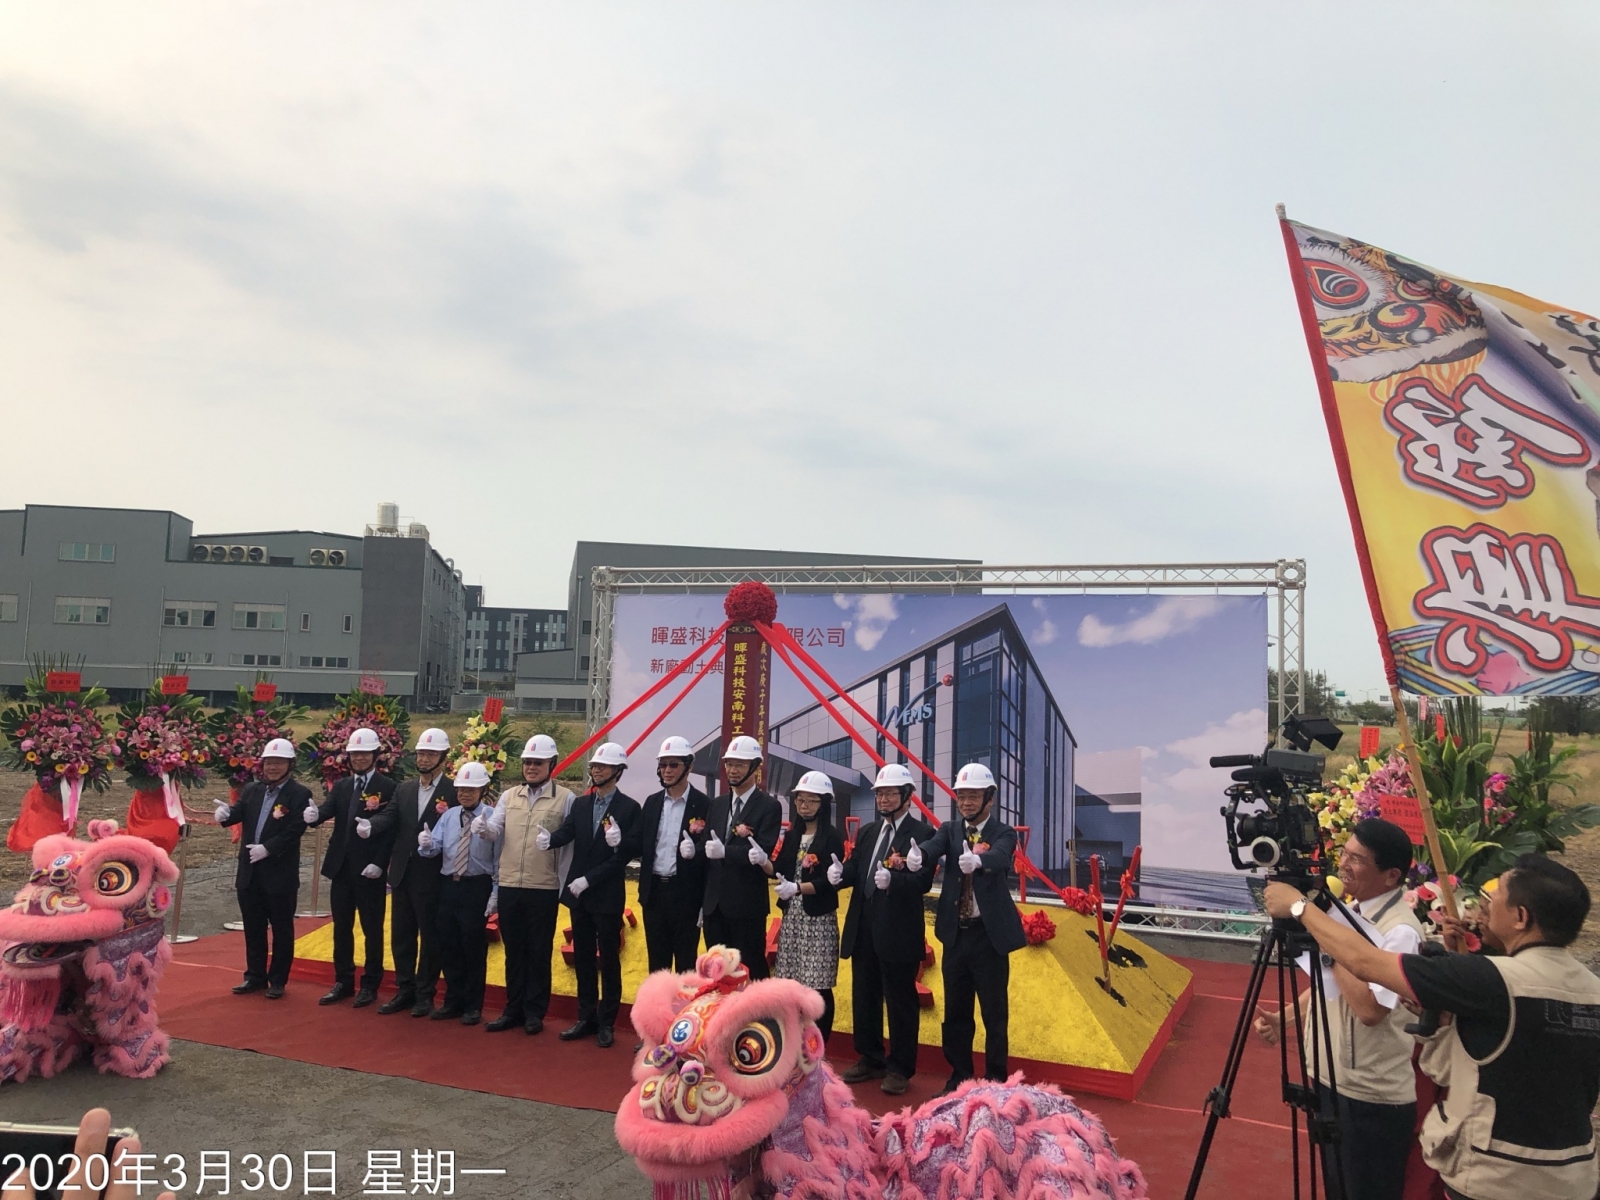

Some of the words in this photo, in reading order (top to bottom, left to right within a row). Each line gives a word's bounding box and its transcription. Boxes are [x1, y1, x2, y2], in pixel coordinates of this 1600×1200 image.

[730, 642, 748, 741] 暉盛科技安南科工
